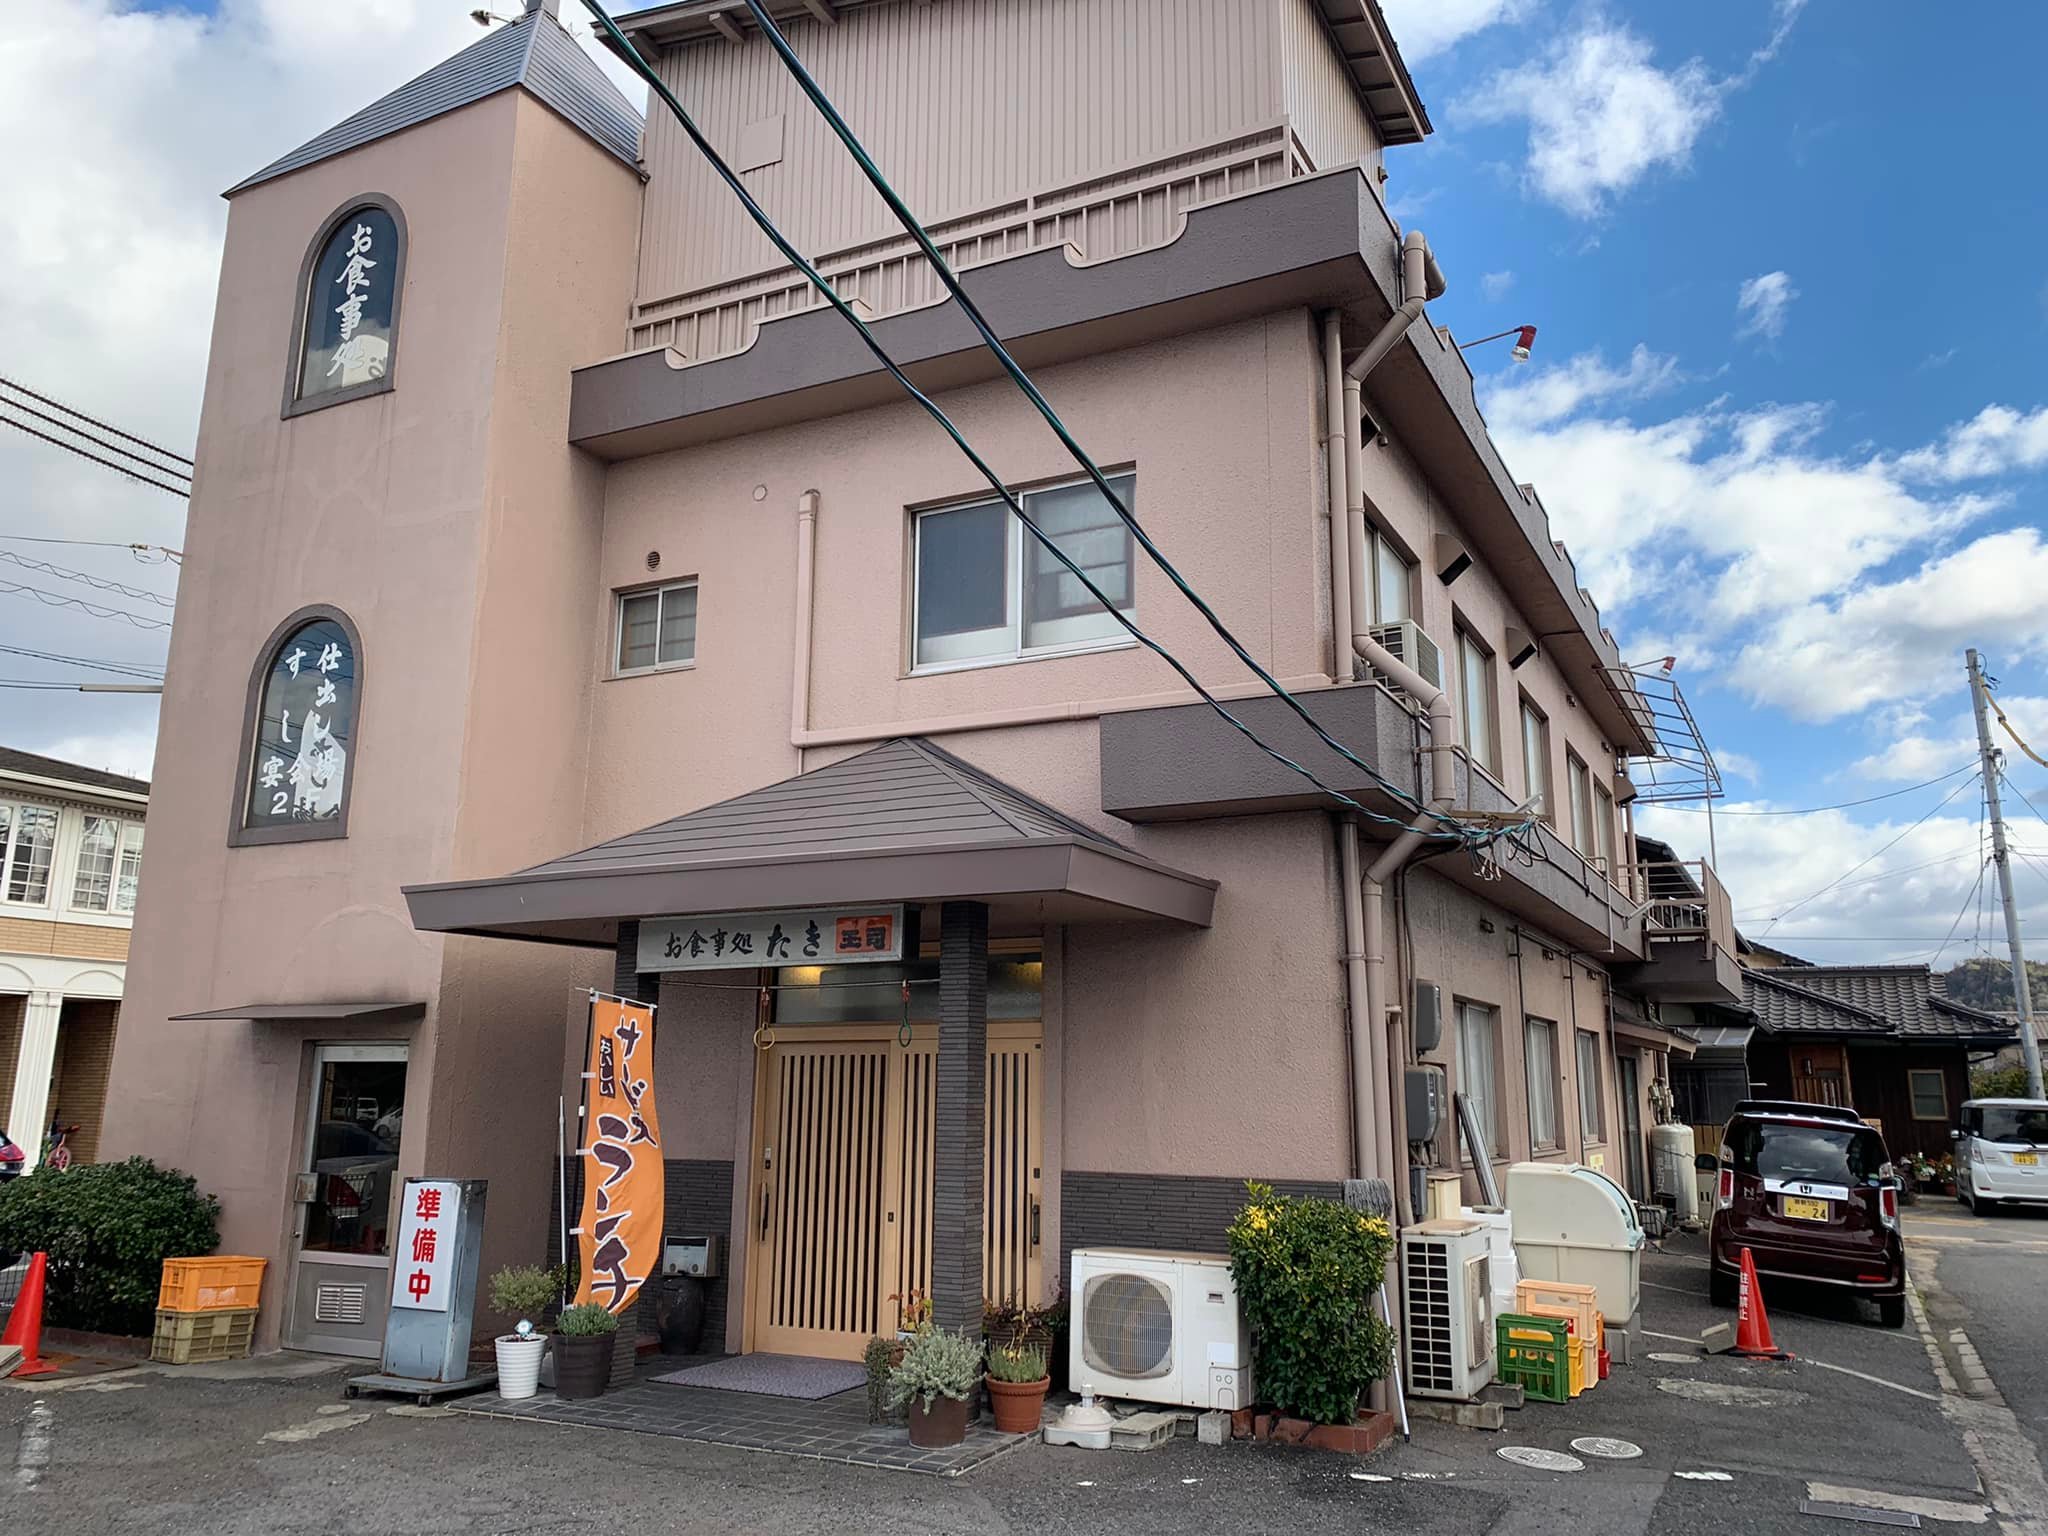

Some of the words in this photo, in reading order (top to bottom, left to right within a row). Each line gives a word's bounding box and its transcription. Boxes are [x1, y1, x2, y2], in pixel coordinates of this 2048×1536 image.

[281, 647, 307, 743] すし
[664, 926, 754, 959] お食事処
[766, 919, 822, 958] たき
[600, 1038, 614, 1096] おいしい
[615, 1016, 659, 1149] サービス
[408, 1188, 442, 1303] 準備中
[590, 1113, 643, 1314] ランチ
